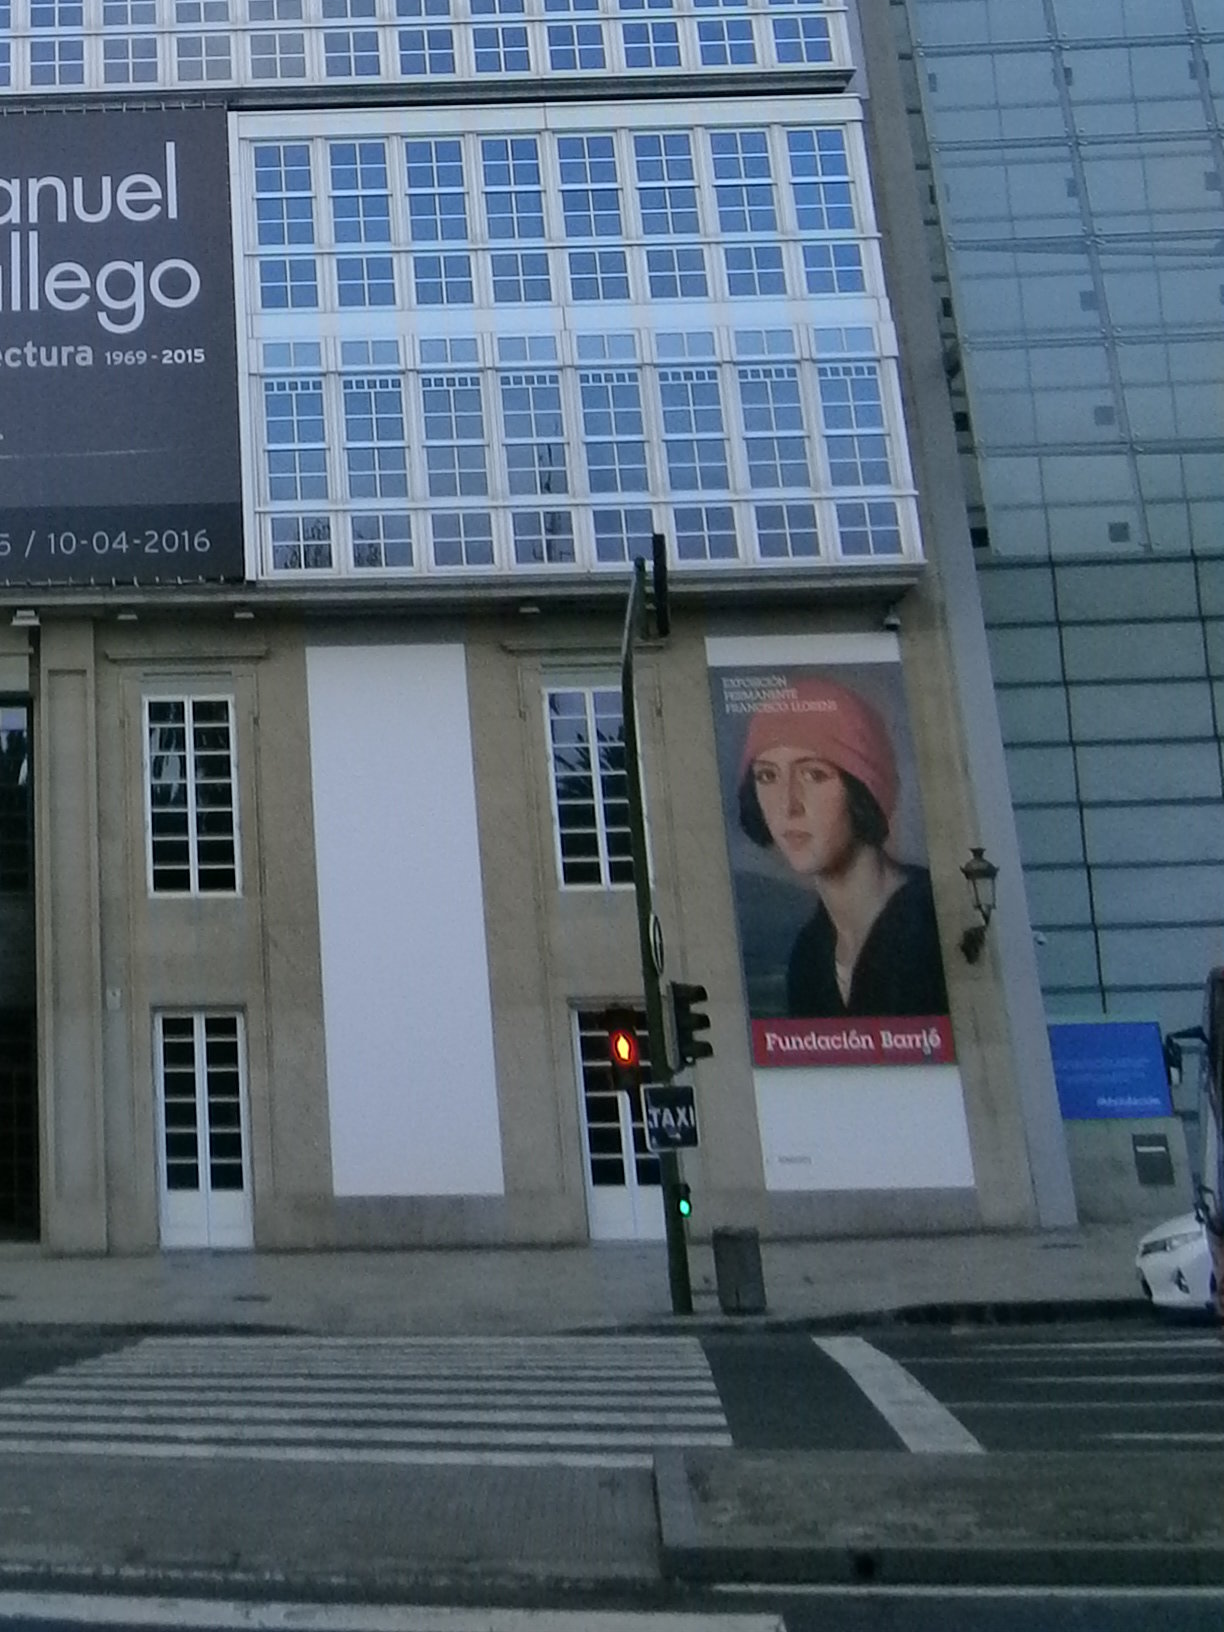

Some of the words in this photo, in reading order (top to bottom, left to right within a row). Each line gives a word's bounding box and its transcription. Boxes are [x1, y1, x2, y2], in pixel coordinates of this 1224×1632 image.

[47, 528, 211, 556] 10-04-2016
[765, 1029, 875, 1052] Fundación
[647, 1105, 695, 1129] TAXI
